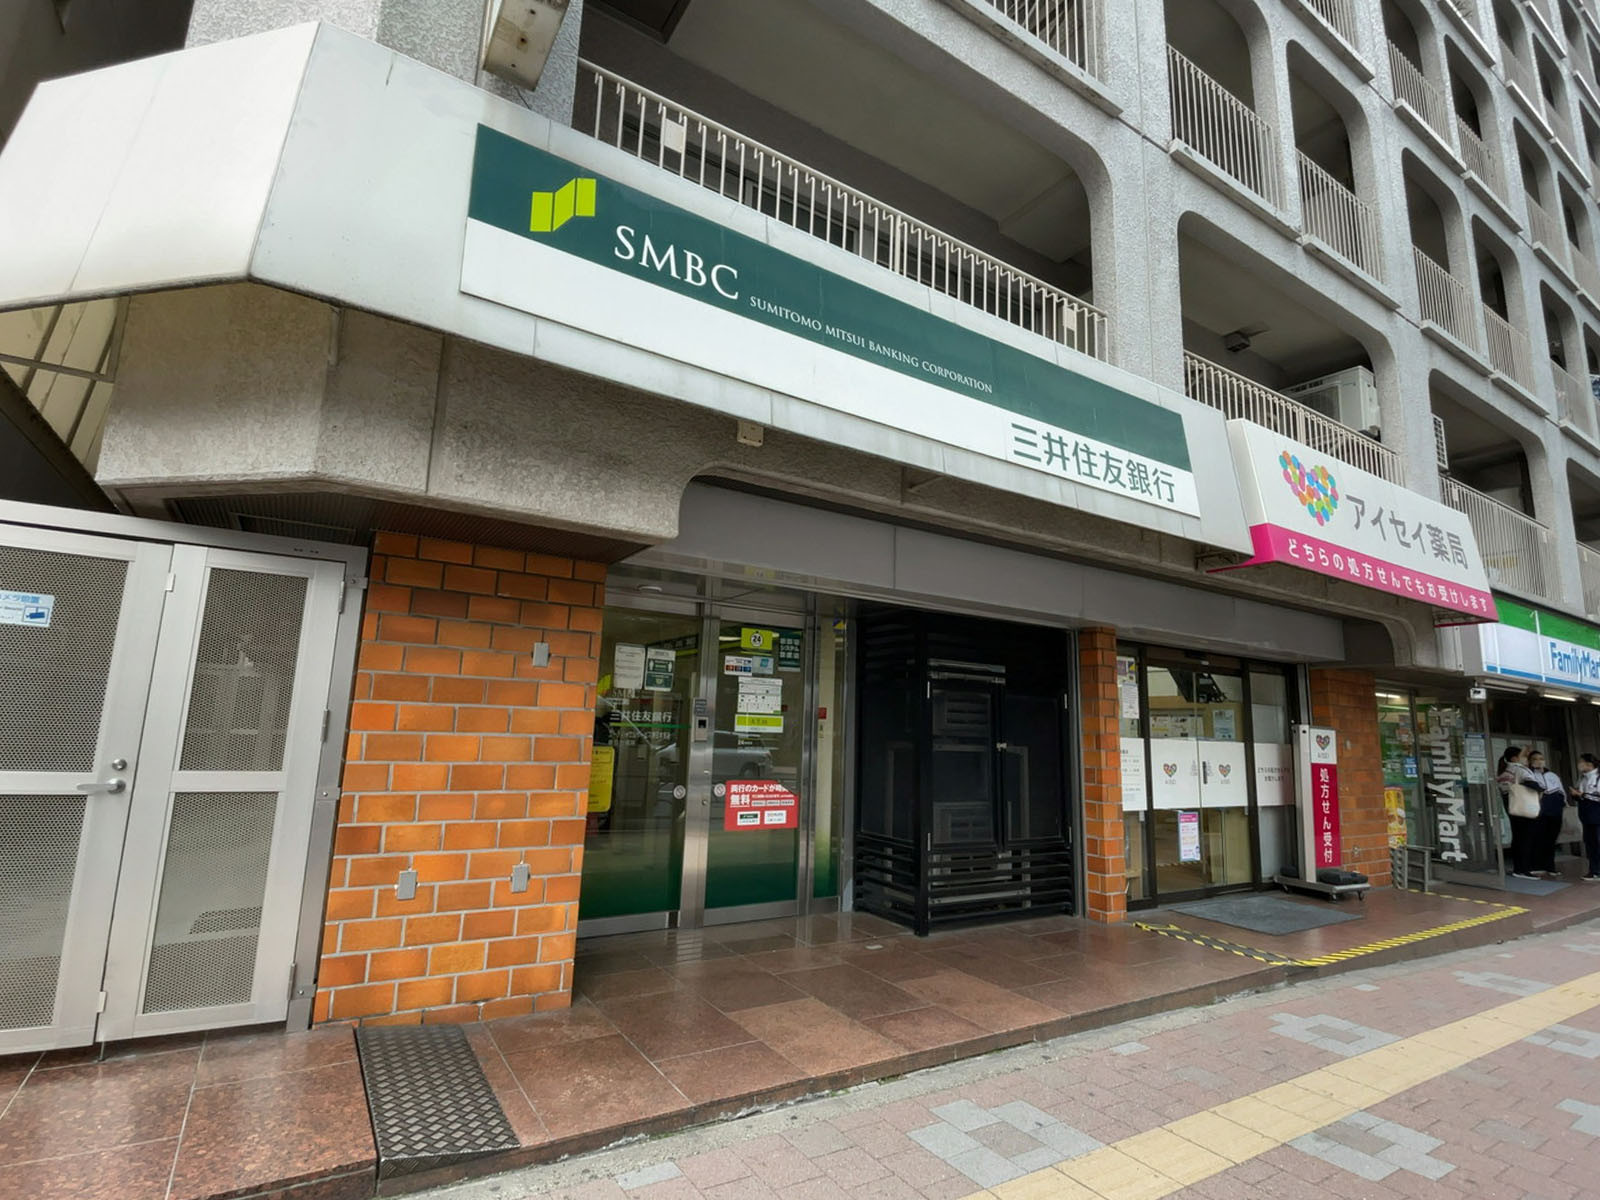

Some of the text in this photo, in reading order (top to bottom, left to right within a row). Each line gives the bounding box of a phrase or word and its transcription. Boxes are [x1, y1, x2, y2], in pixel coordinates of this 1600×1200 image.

[614, 225, 739, 300] SMBC
[750, 296, 993, 394] SUMITOMO MITSUI BANKING CORPORATION
[1011, 423, 1175, 503] 三井住友銀行
[1345, 494, 1468, 570] アイセイ薬局
[1288, 538, 1488, 612] どちらの処方せんでもお受けします
[1550, 641, 1600, 682] FamilyMar
[1319, 767, 1334, 864] 処方せん受付
[1426, 707, 1469, 862] FamilyMart
